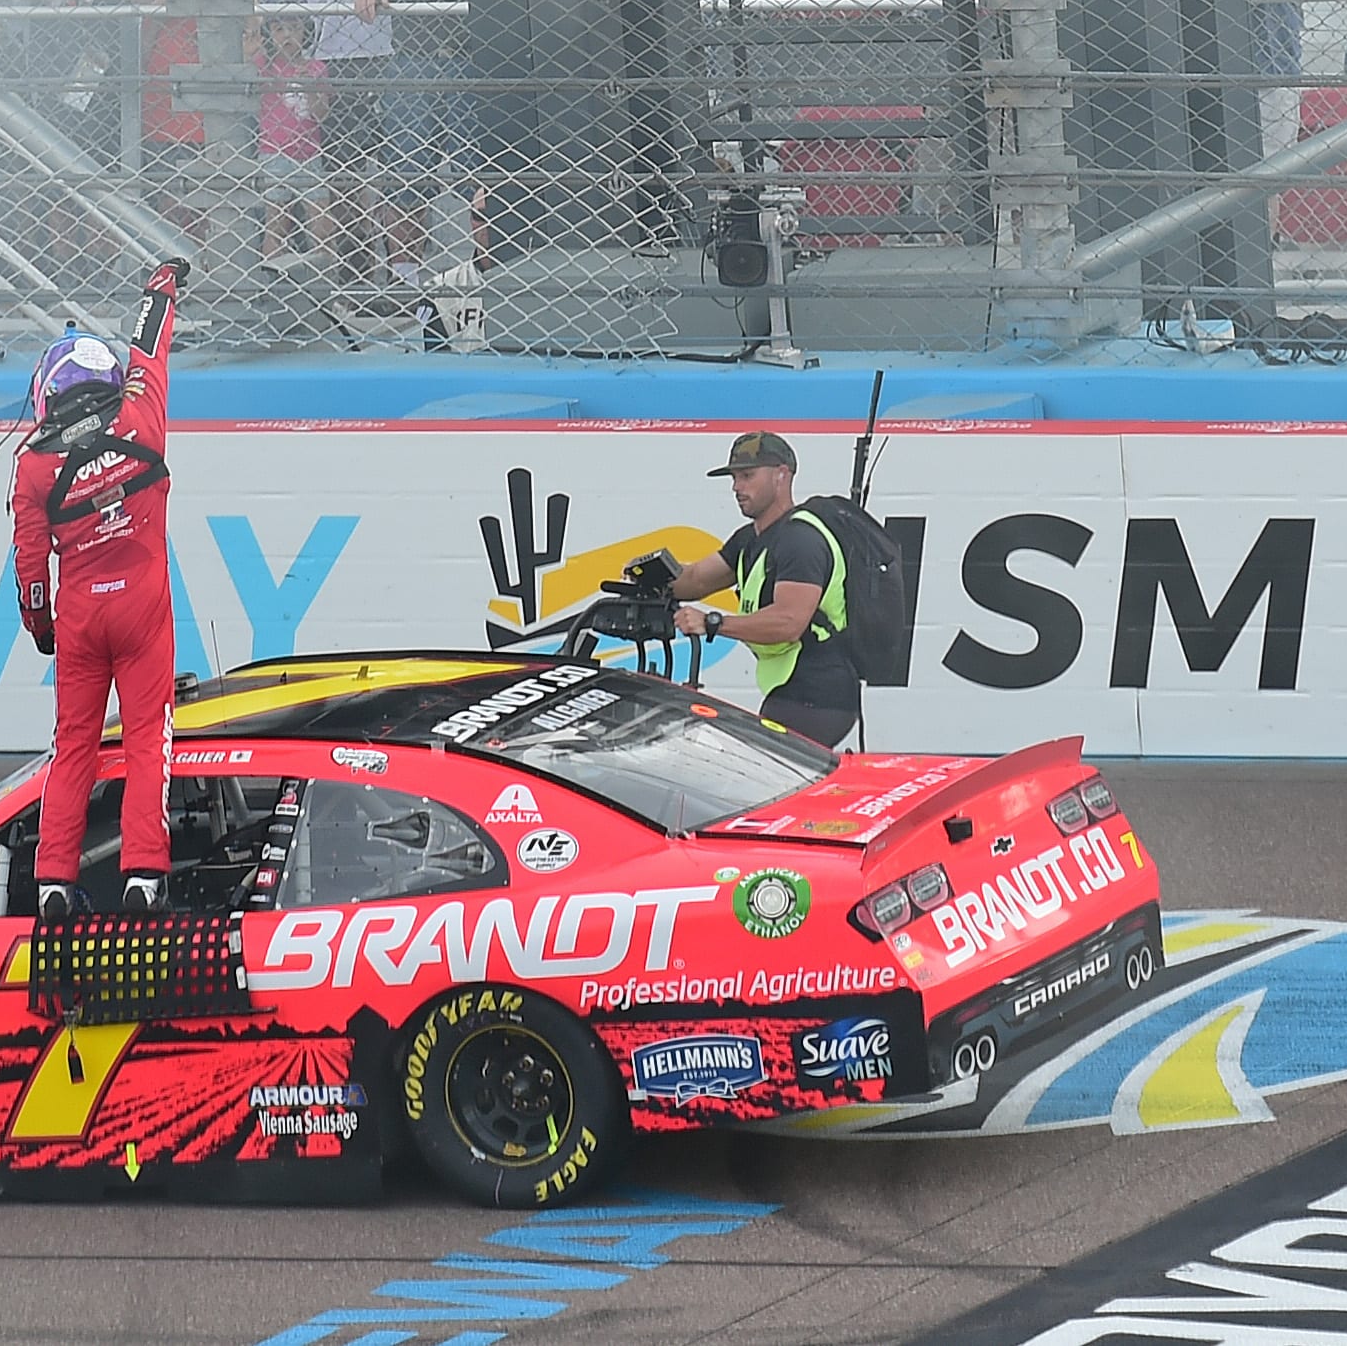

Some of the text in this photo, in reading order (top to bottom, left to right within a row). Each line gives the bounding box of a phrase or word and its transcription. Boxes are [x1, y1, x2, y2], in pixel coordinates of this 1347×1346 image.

[867, 512, 1307, 690] ISM
[531, 688, 621, 731] ALLGAIER
[484, 811, 544, 825] AXALTA
[930, 826, 1145, 969] BRANDT.CO 7
[247, 885, 719, 990] BRANDT
[743, 910, 809, 940] ETHANOL
[580, 964, 897, 1011] Professional Agriculture
[1013, 951, 1111, 1017] CAMARO
[642, 1041, 754, 1080] HELLMANN'S
[800, 1027, 890, 1066] Suave
[845, 1056, 894, 1082] MEN
[250, 1086, 345, 1107] ARMOUR
[258, 1110, 358, 1140] Vienna Sausage
